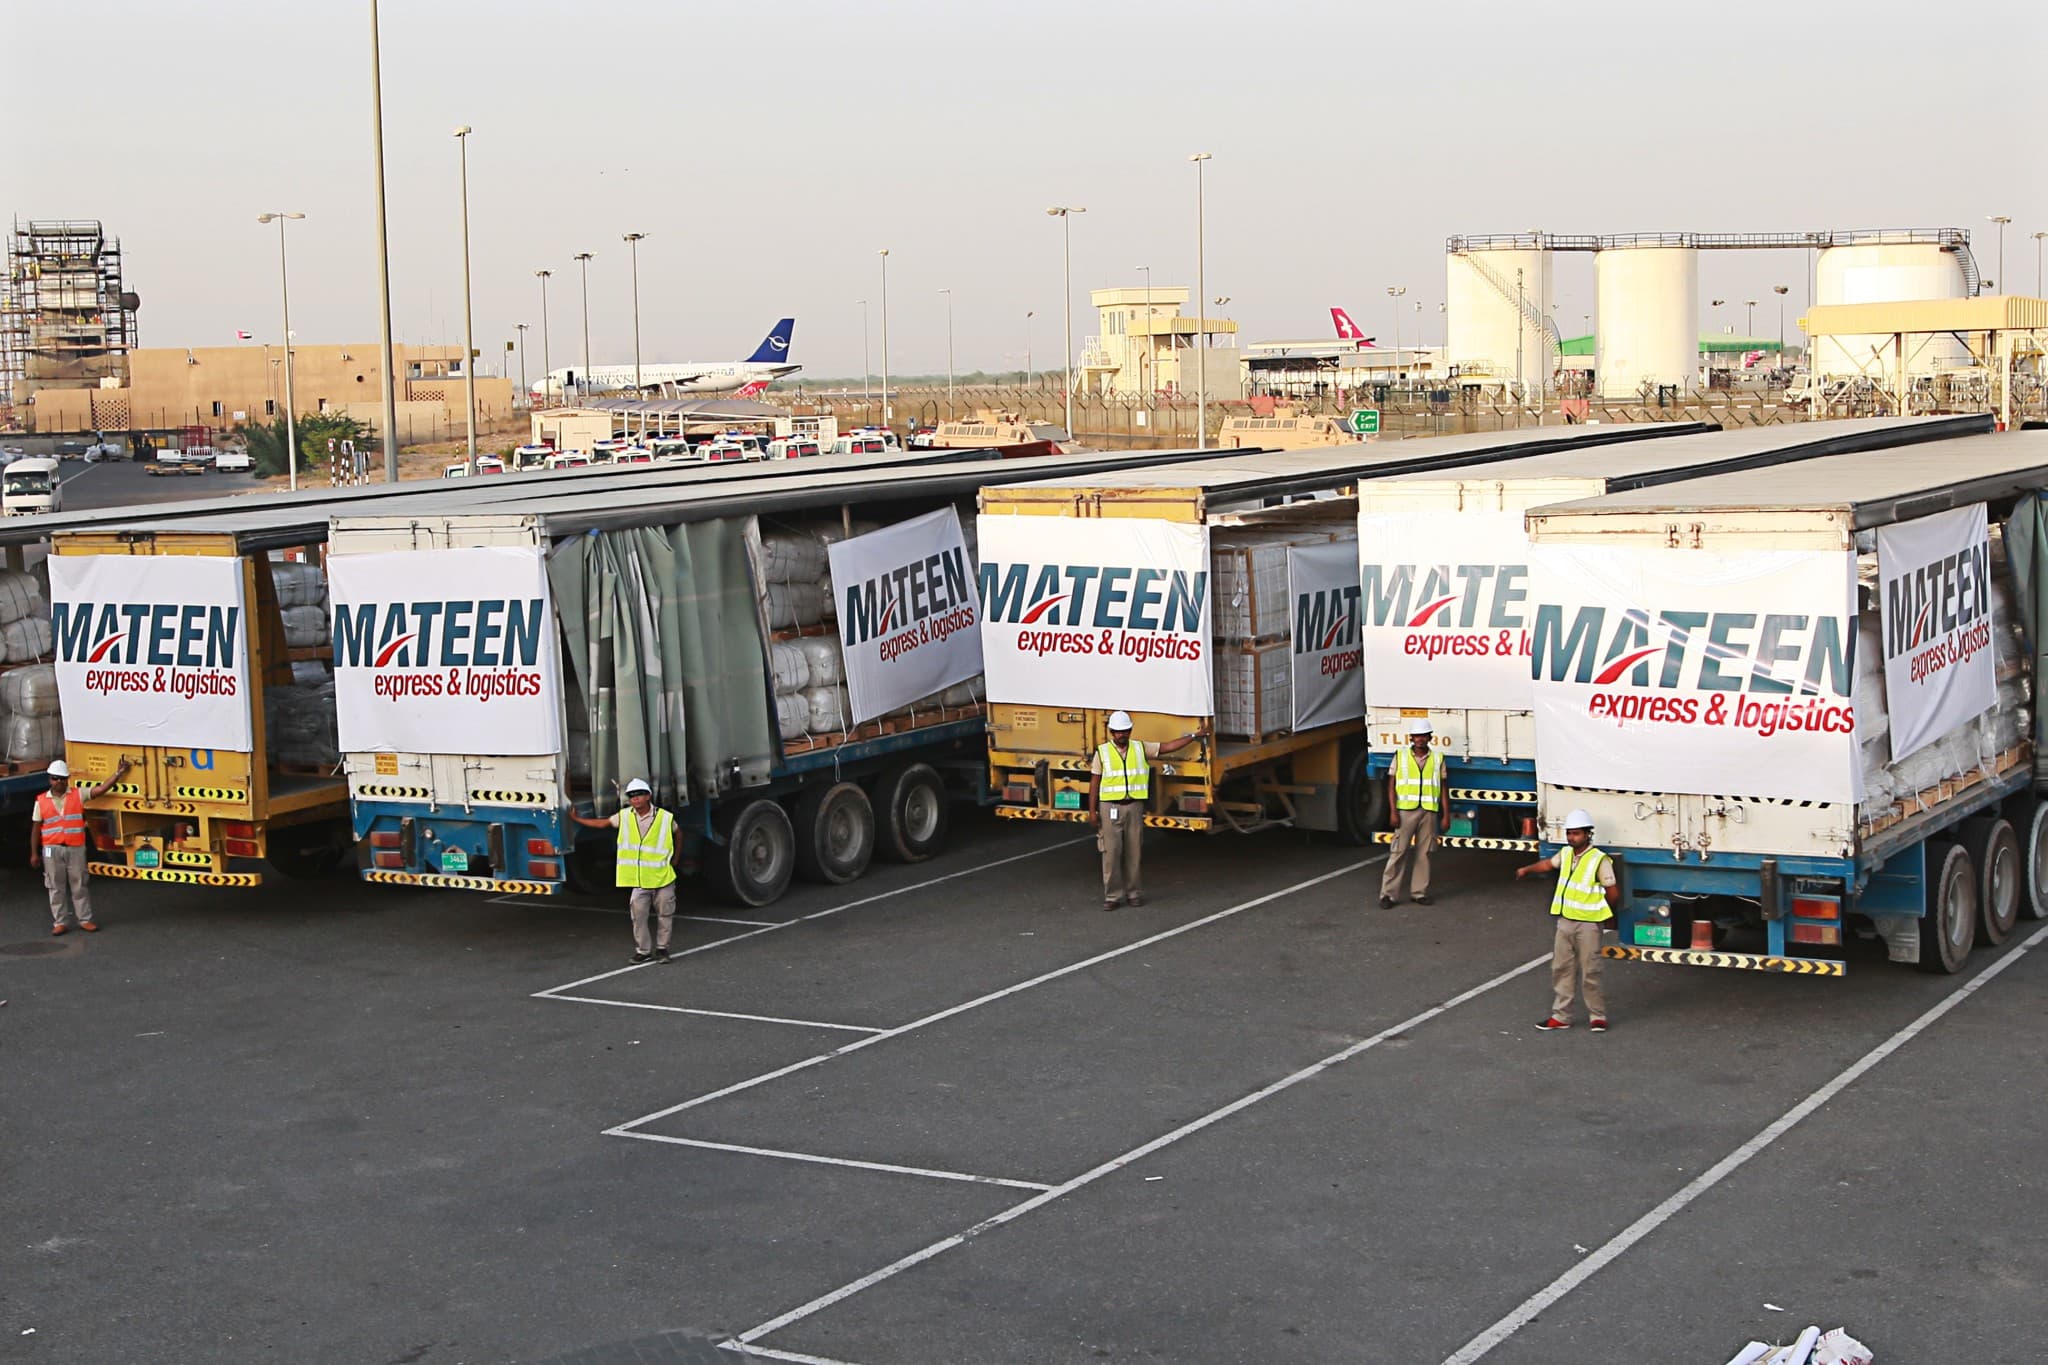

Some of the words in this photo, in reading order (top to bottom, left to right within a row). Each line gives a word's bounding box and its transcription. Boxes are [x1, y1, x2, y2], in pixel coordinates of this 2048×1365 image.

[846, 547, 968, 646] MATEEN
[980, 563, 1207, 632] MATEEN
[1296, 585, 1362, 654] MAT
[1362, 564, 1530, 628] MATE
[1888, 541, 1989, 660] MATEEN
[52, 602, 239, 669] MATEEN
[334, 599, 544, 668] MATEEN
[880, 626, 918, 663] express
[920, 621, 930, 644] &
[930, 606, 974, 642] logistics
[1018, 630, 1094, 657] express
[1098, 629, 1114, 656] &
[1119, 630, 1201, 663] logistics
[1405, 632, 1489, 661] express
[1495, 629, 1513, 656] &
[1531, 604, 1858, 697] MATEEN
[1911, 642, 1945, 684] express
[1948, 634, 1957, 661] &
[1958, 618, 1990, 662] logistics
[86, 668, 149, 695] express
[153, 667, 167, 693] &
[171, 667, 236, 699] logistics
[375, 672, 443, 703] express
[447, 668, 461, 696] &
[466, 672, 541, 703] logistics
[1589, 693, 1698, 731] express
[1704, 693, 1729, 727] &
[1734, 693, 1856, 738] logistics
